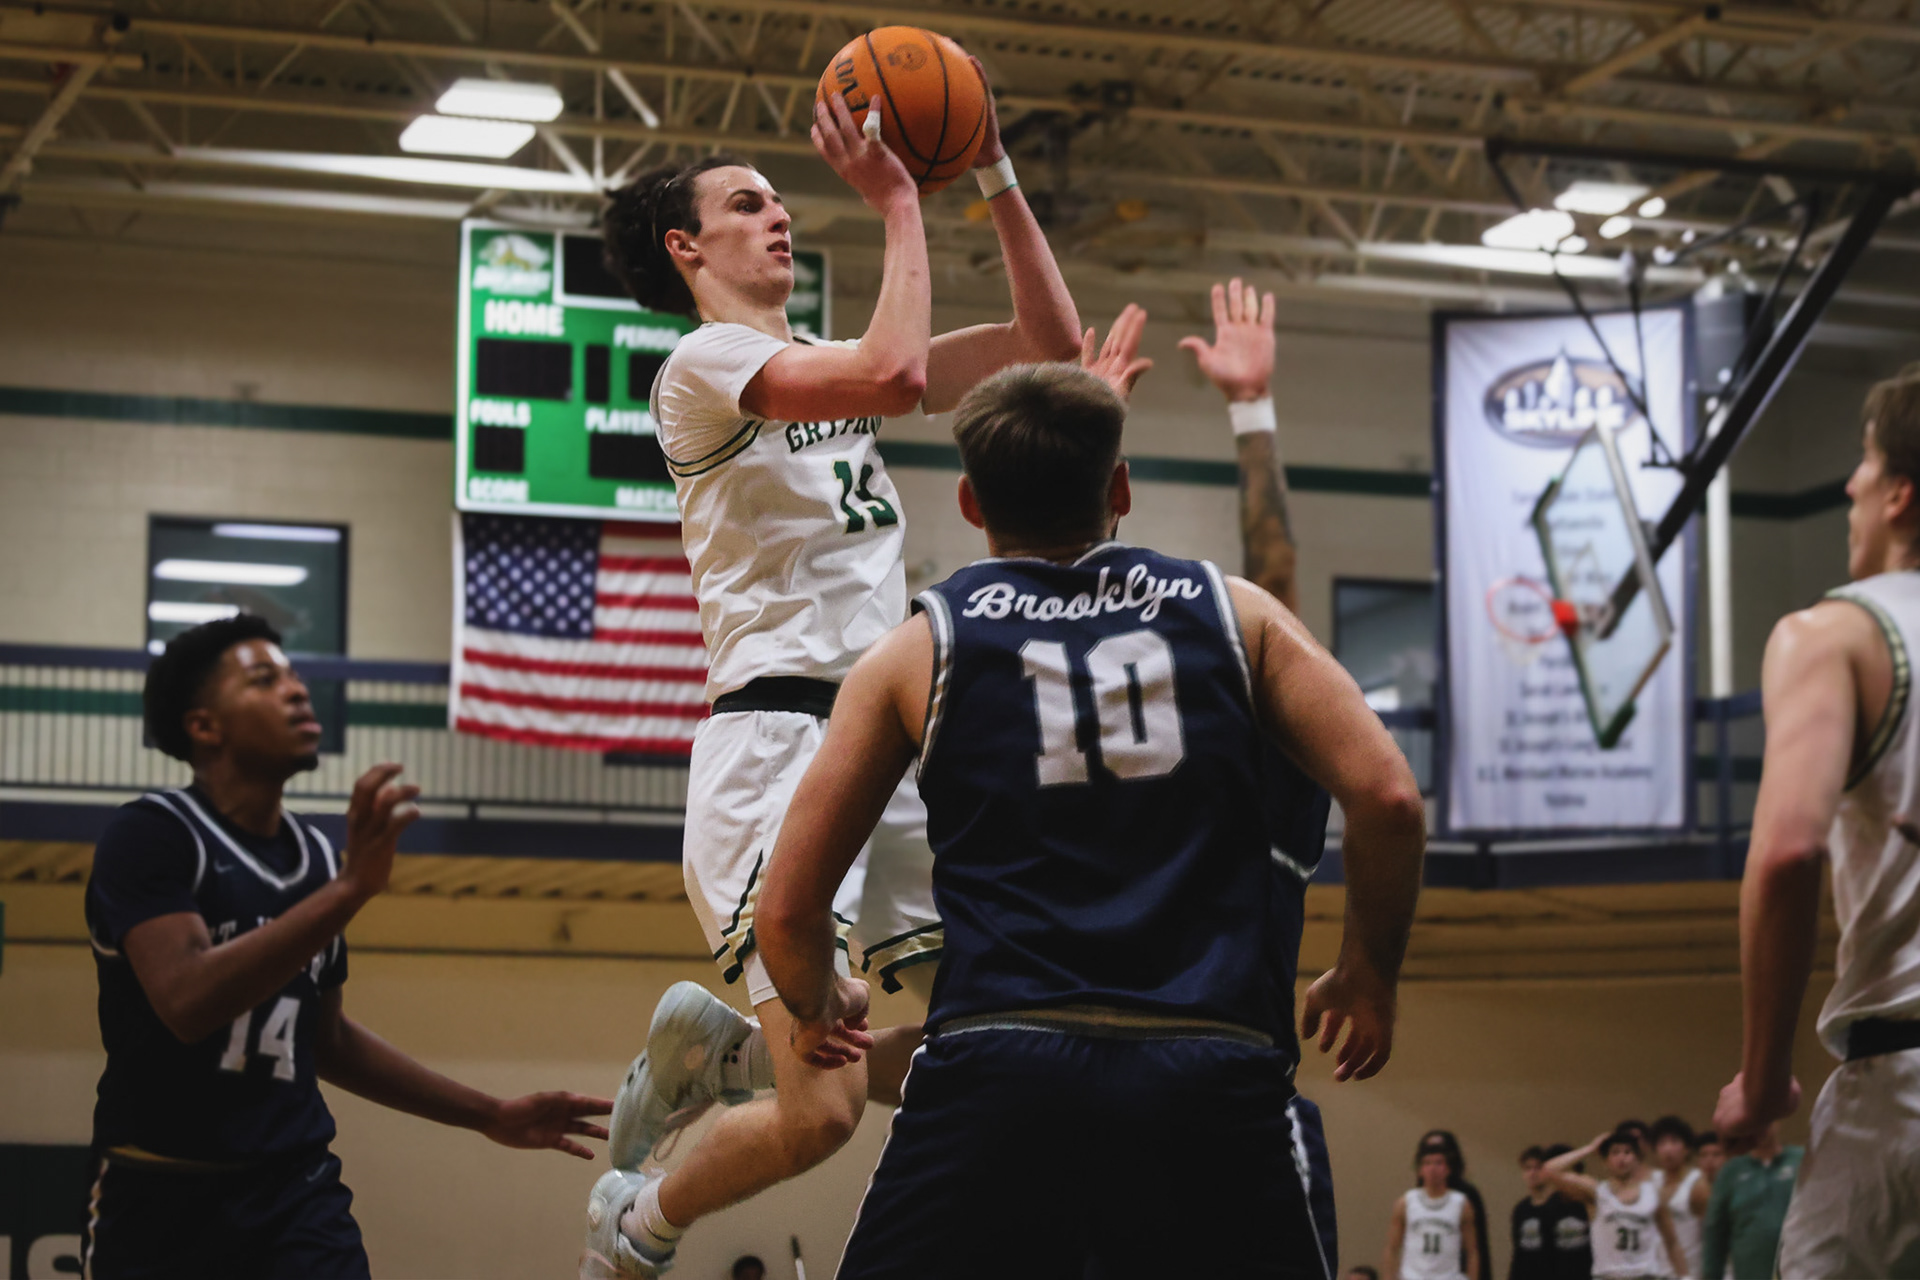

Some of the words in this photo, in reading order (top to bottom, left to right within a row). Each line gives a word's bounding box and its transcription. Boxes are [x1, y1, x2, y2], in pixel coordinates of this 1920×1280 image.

[485, 300, 564, 337] HOME
[470, 399, 531, 426] FOULS
[468, 478, 529, 503] SCORE
[962, 563, 1203, 623] Brooklyn
[1018, 629, 1187, 789] 10
[219, 996, 301, 1082] 14
